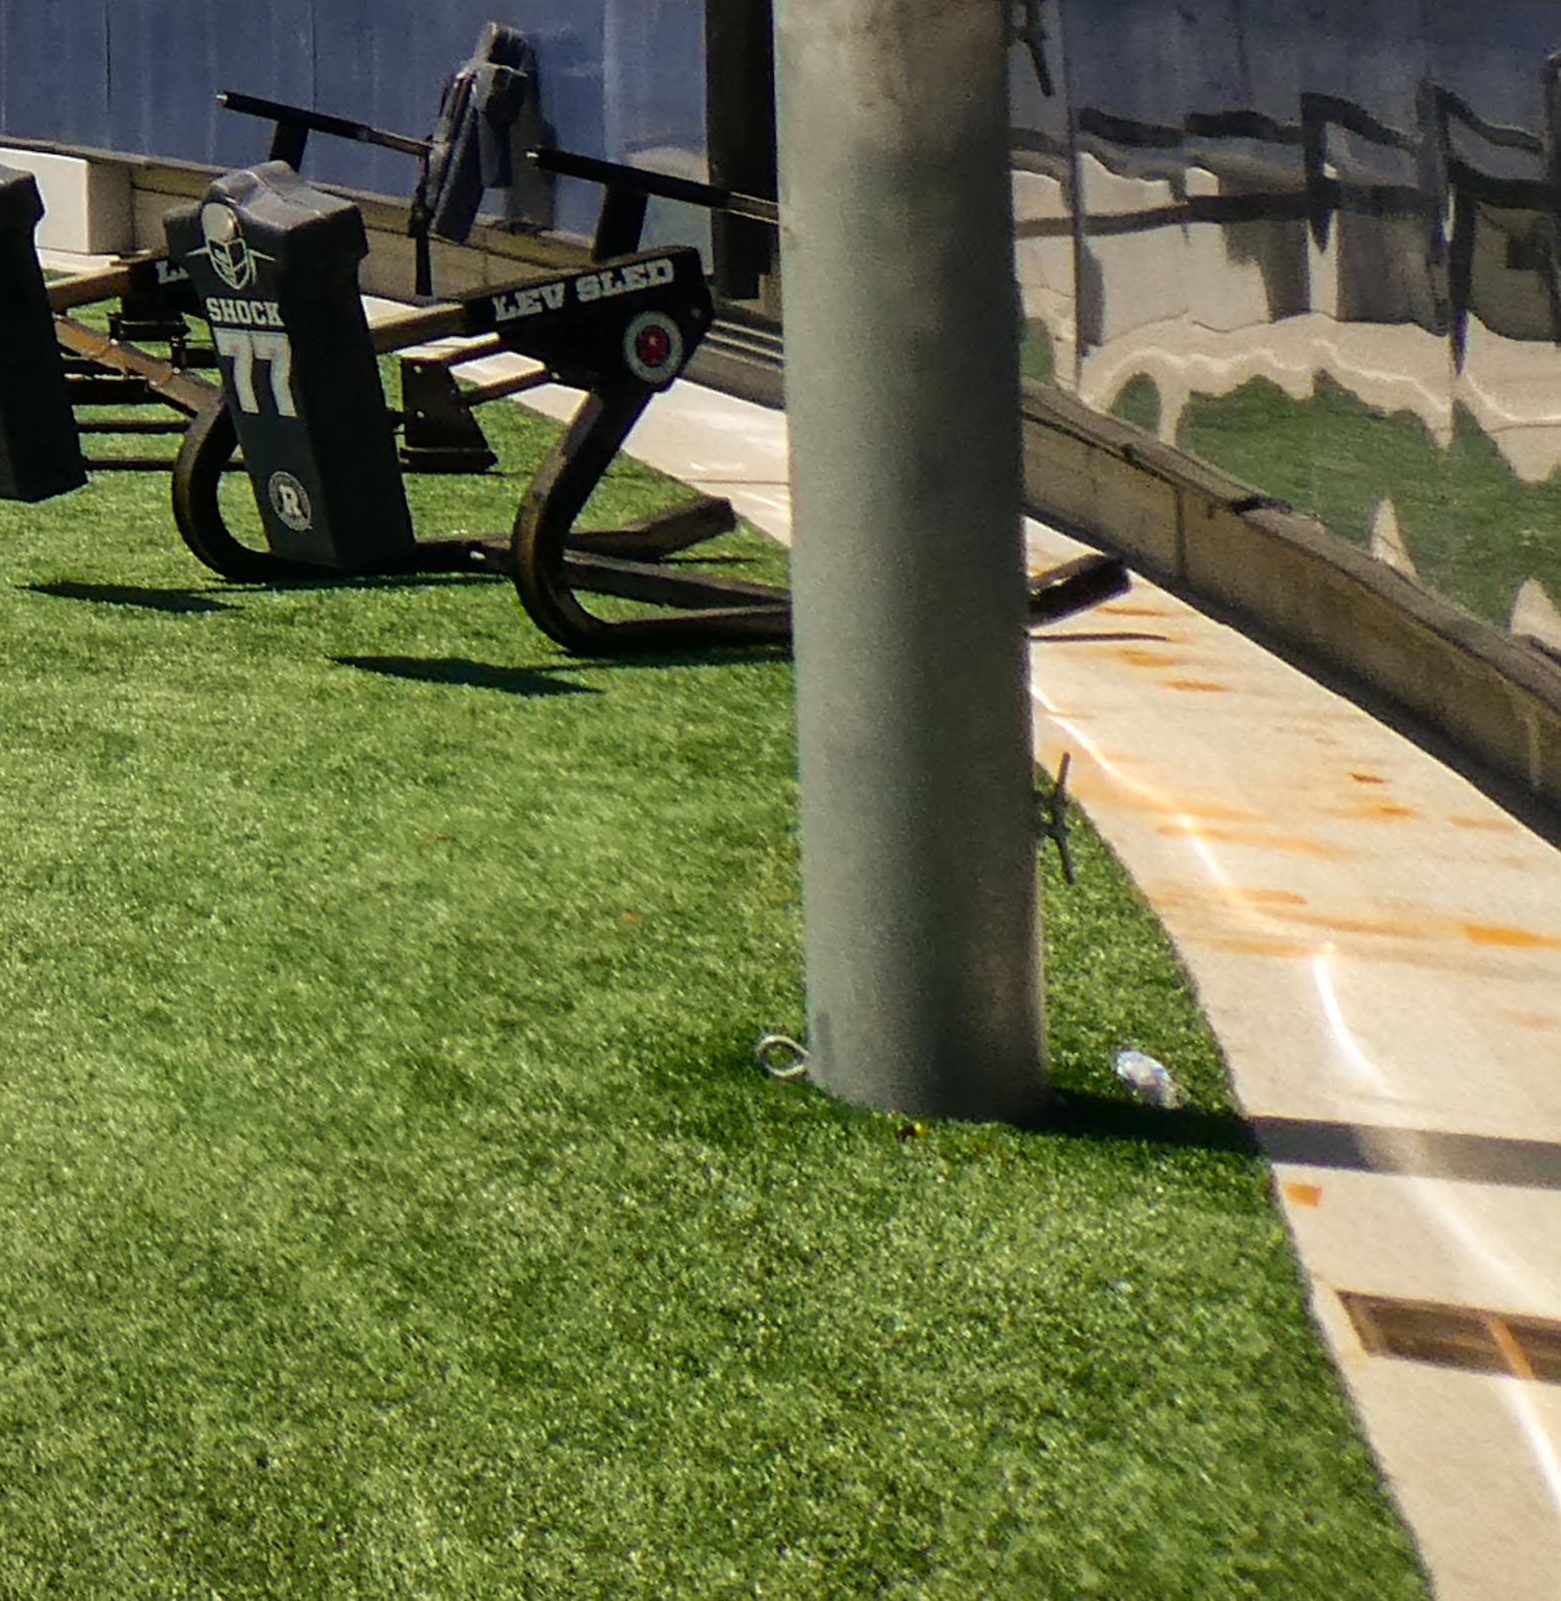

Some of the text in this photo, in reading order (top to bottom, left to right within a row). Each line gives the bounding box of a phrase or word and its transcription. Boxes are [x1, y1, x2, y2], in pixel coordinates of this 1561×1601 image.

[206, 298, 285, 327] SHOCK
[491, 258, 675, 322] LEV SLED
[213, 327, 297, 417] 77
